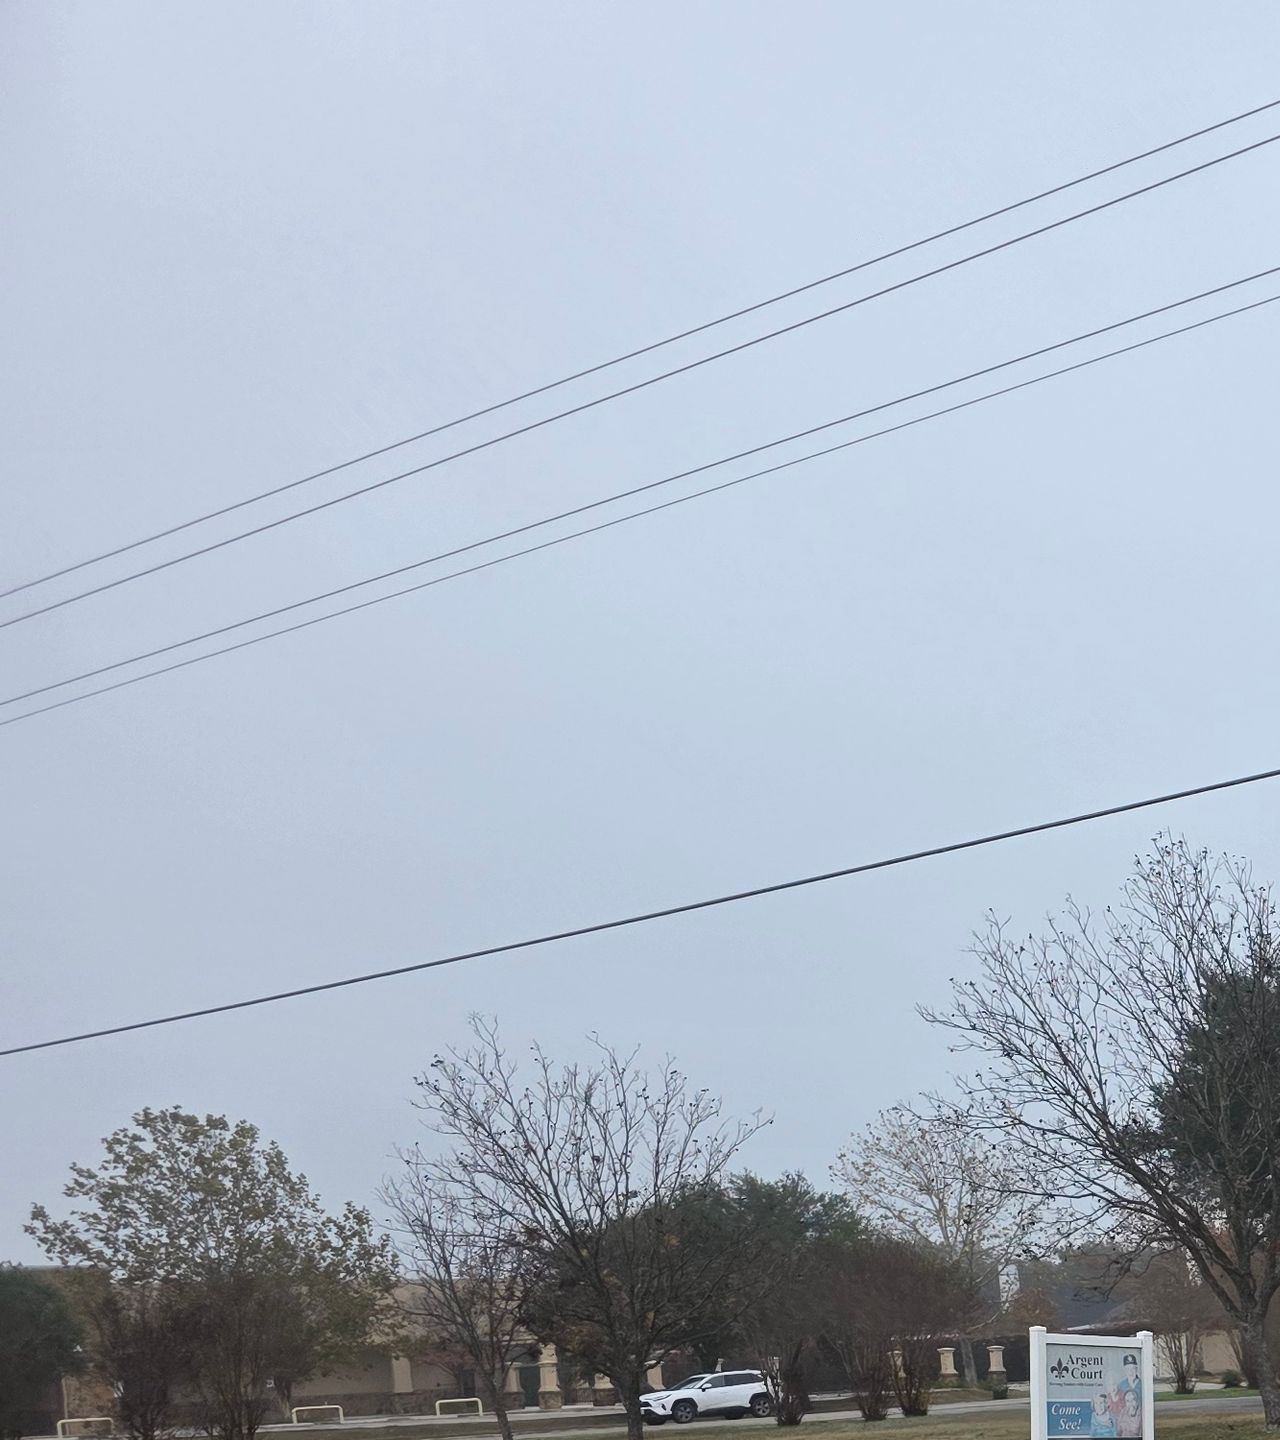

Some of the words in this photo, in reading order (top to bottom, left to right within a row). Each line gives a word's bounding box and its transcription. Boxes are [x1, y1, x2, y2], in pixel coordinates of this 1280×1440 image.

[1067, 1354, 1103, 1368] Argent
[1071, 1367, 1102, 1379] Court
[1051, 1403, 1081, 1416] Come
[1058, 1418, 1082, 1430] See!
